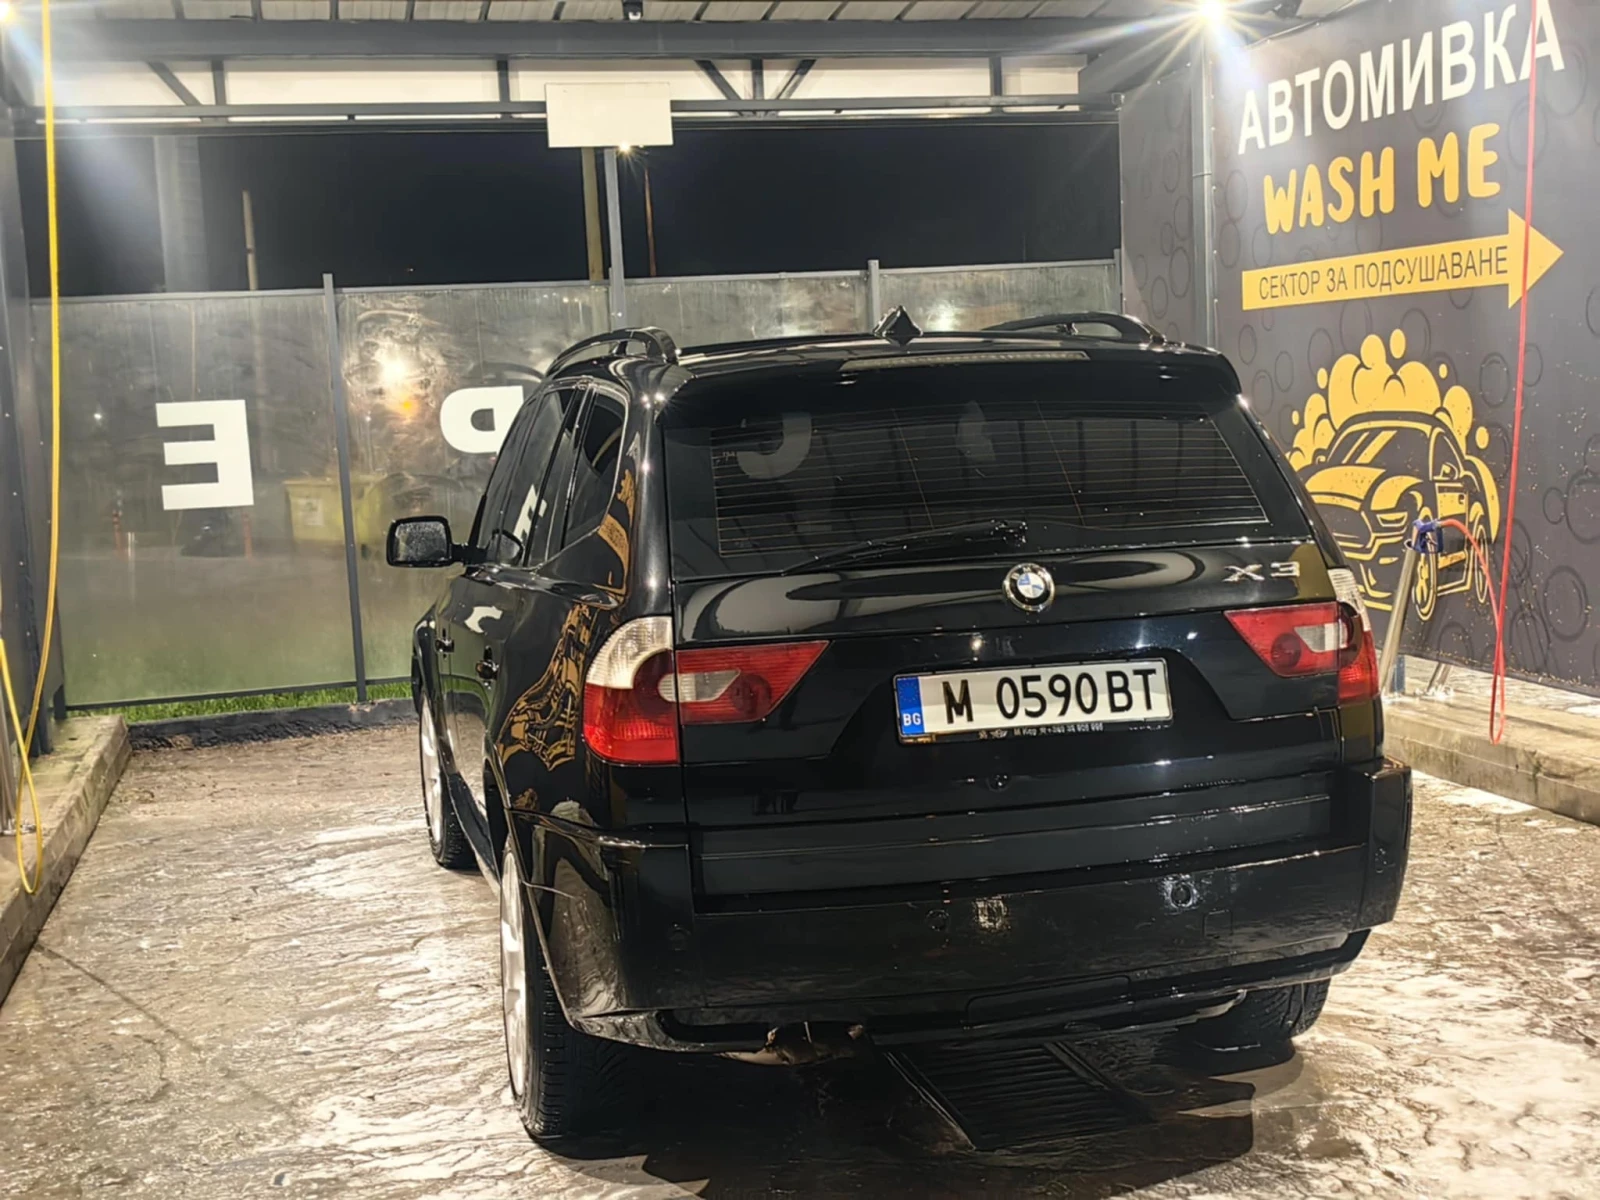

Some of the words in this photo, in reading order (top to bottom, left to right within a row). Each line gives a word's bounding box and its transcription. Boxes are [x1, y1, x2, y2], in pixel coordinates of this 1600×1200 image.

[1238, 0, 1565, 154] АВТОМИВКА
[1263, 147, 1394, 235] WASH
[1417, 123, 1500, 208] ME
[1259, 270, 1320, 300] СЕКТОР
[1326, 267, 1349, 293] ЗА
[1354, 246, 1508, 296] ПОДСУШАВАНЕ
[1223, 561, 1300, 583] X3
[902, 712, 922, 727] BG
